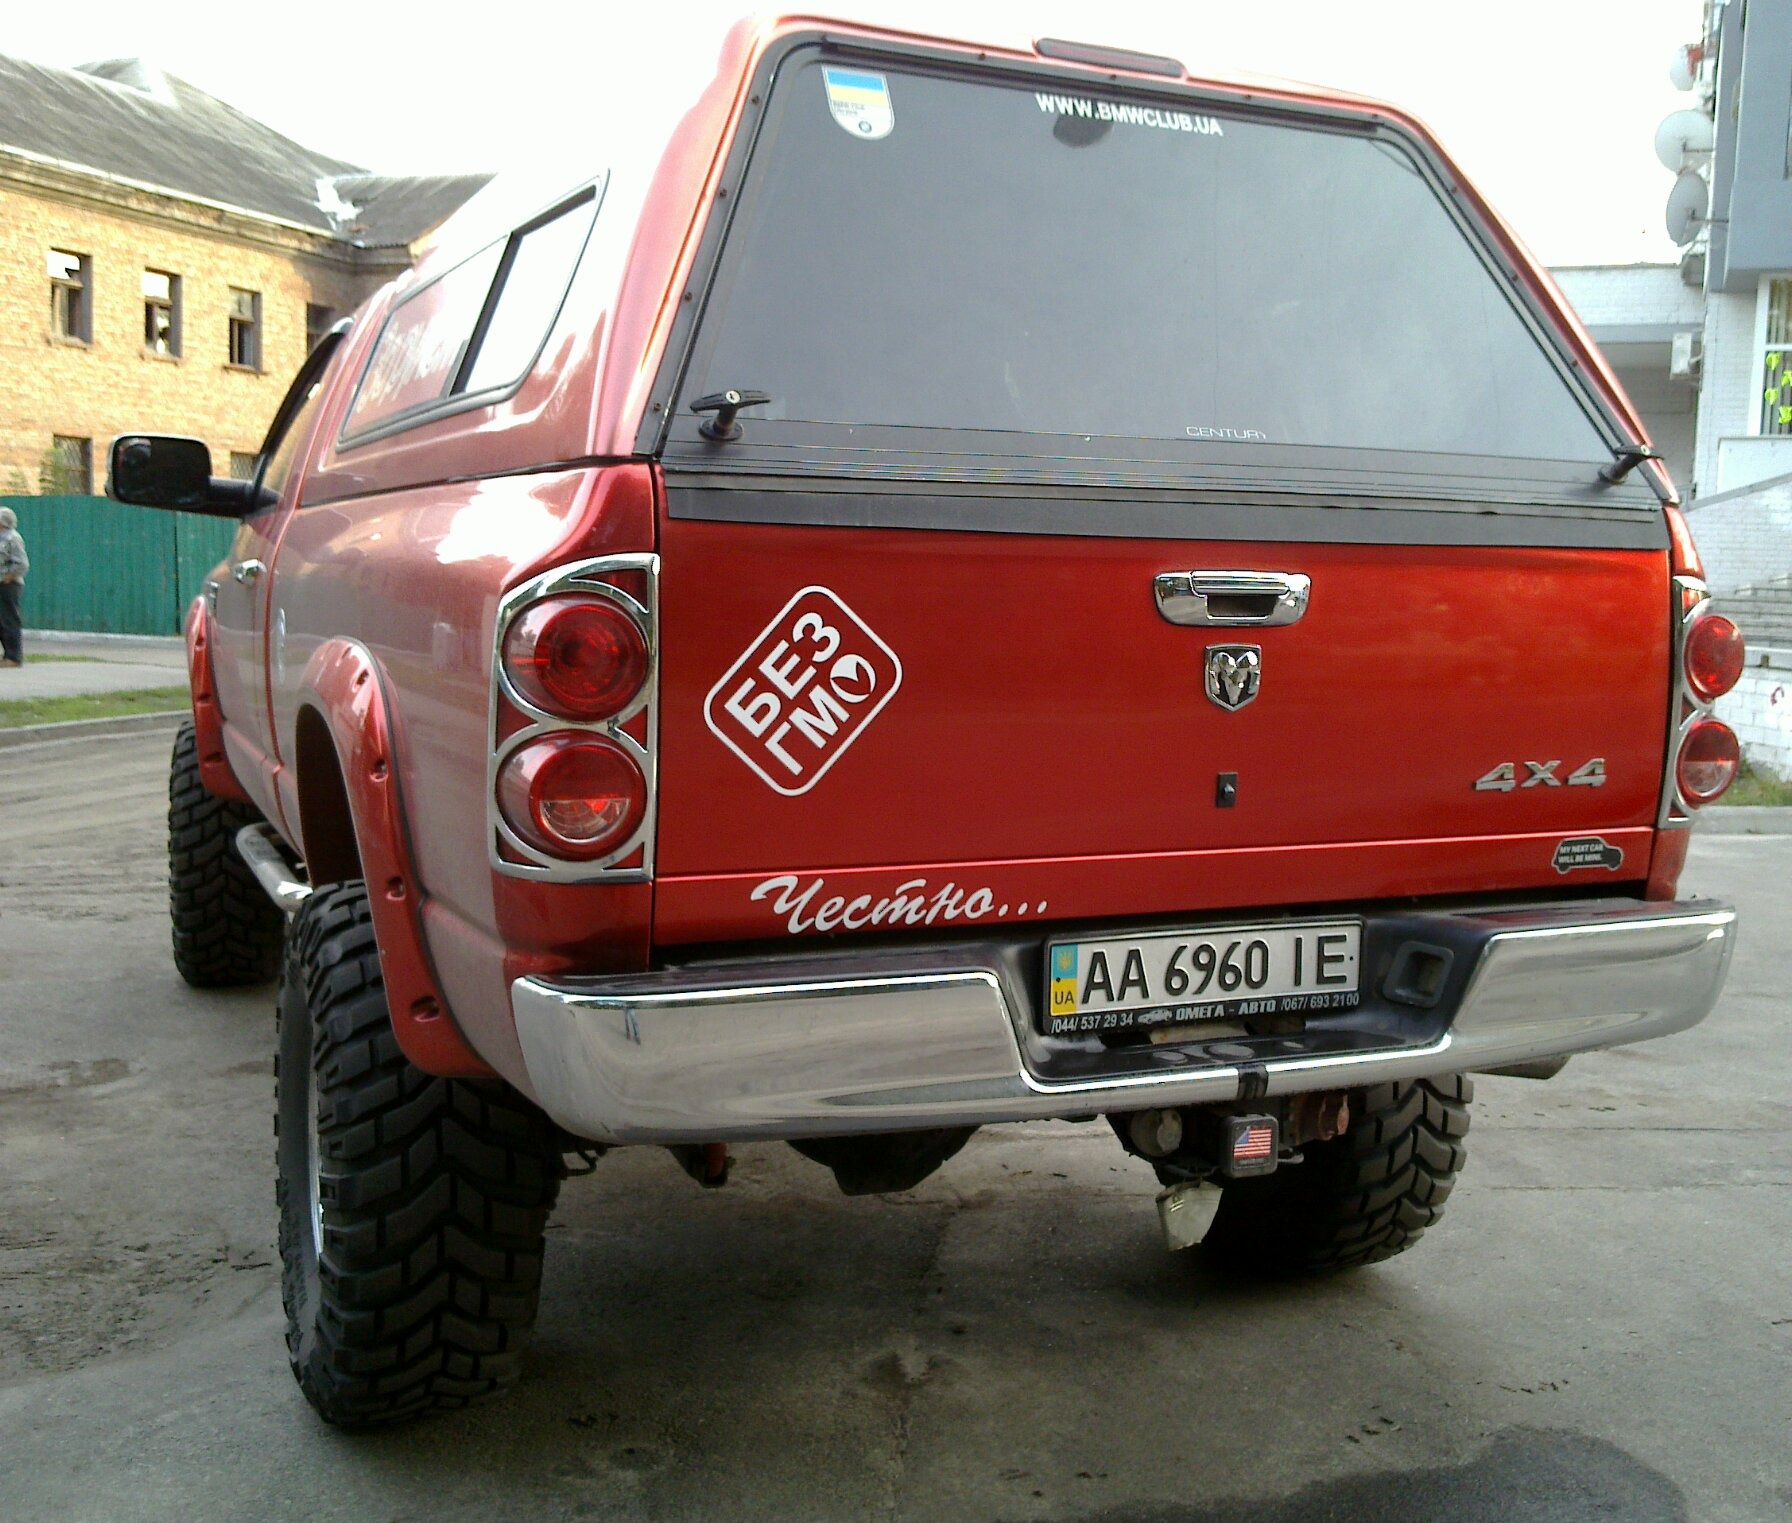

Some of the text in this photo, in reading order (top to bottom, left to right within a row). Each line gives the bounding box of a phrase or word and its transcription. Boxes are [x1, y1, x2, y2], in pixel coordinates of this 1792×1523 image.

[1035, 93, 1223, 136] WWW.BMWCLUB.UA
[724, 612, 841, 738] БЕЗ
[764, 654, 876, 776] ГМО
[1558, 855, 1574, 863] WILL
[1560, 844, 1604, 854] MY NEXT CAR
[1081, 934, 1347, 1005] AA 6960 IE
[1055, 991, 1074, 1005] UA
[1081, 1015, 1101, 1029] 537
[1103, 1014, 1117, 1028] 29
[1120, 1013, 1133, 1026] 34
[1176, 1004, 1224, 1021] ОМЕГА
[1238, 999, 1276, 1015] АВТО
[1310, 994, 1330, 1008] 693
